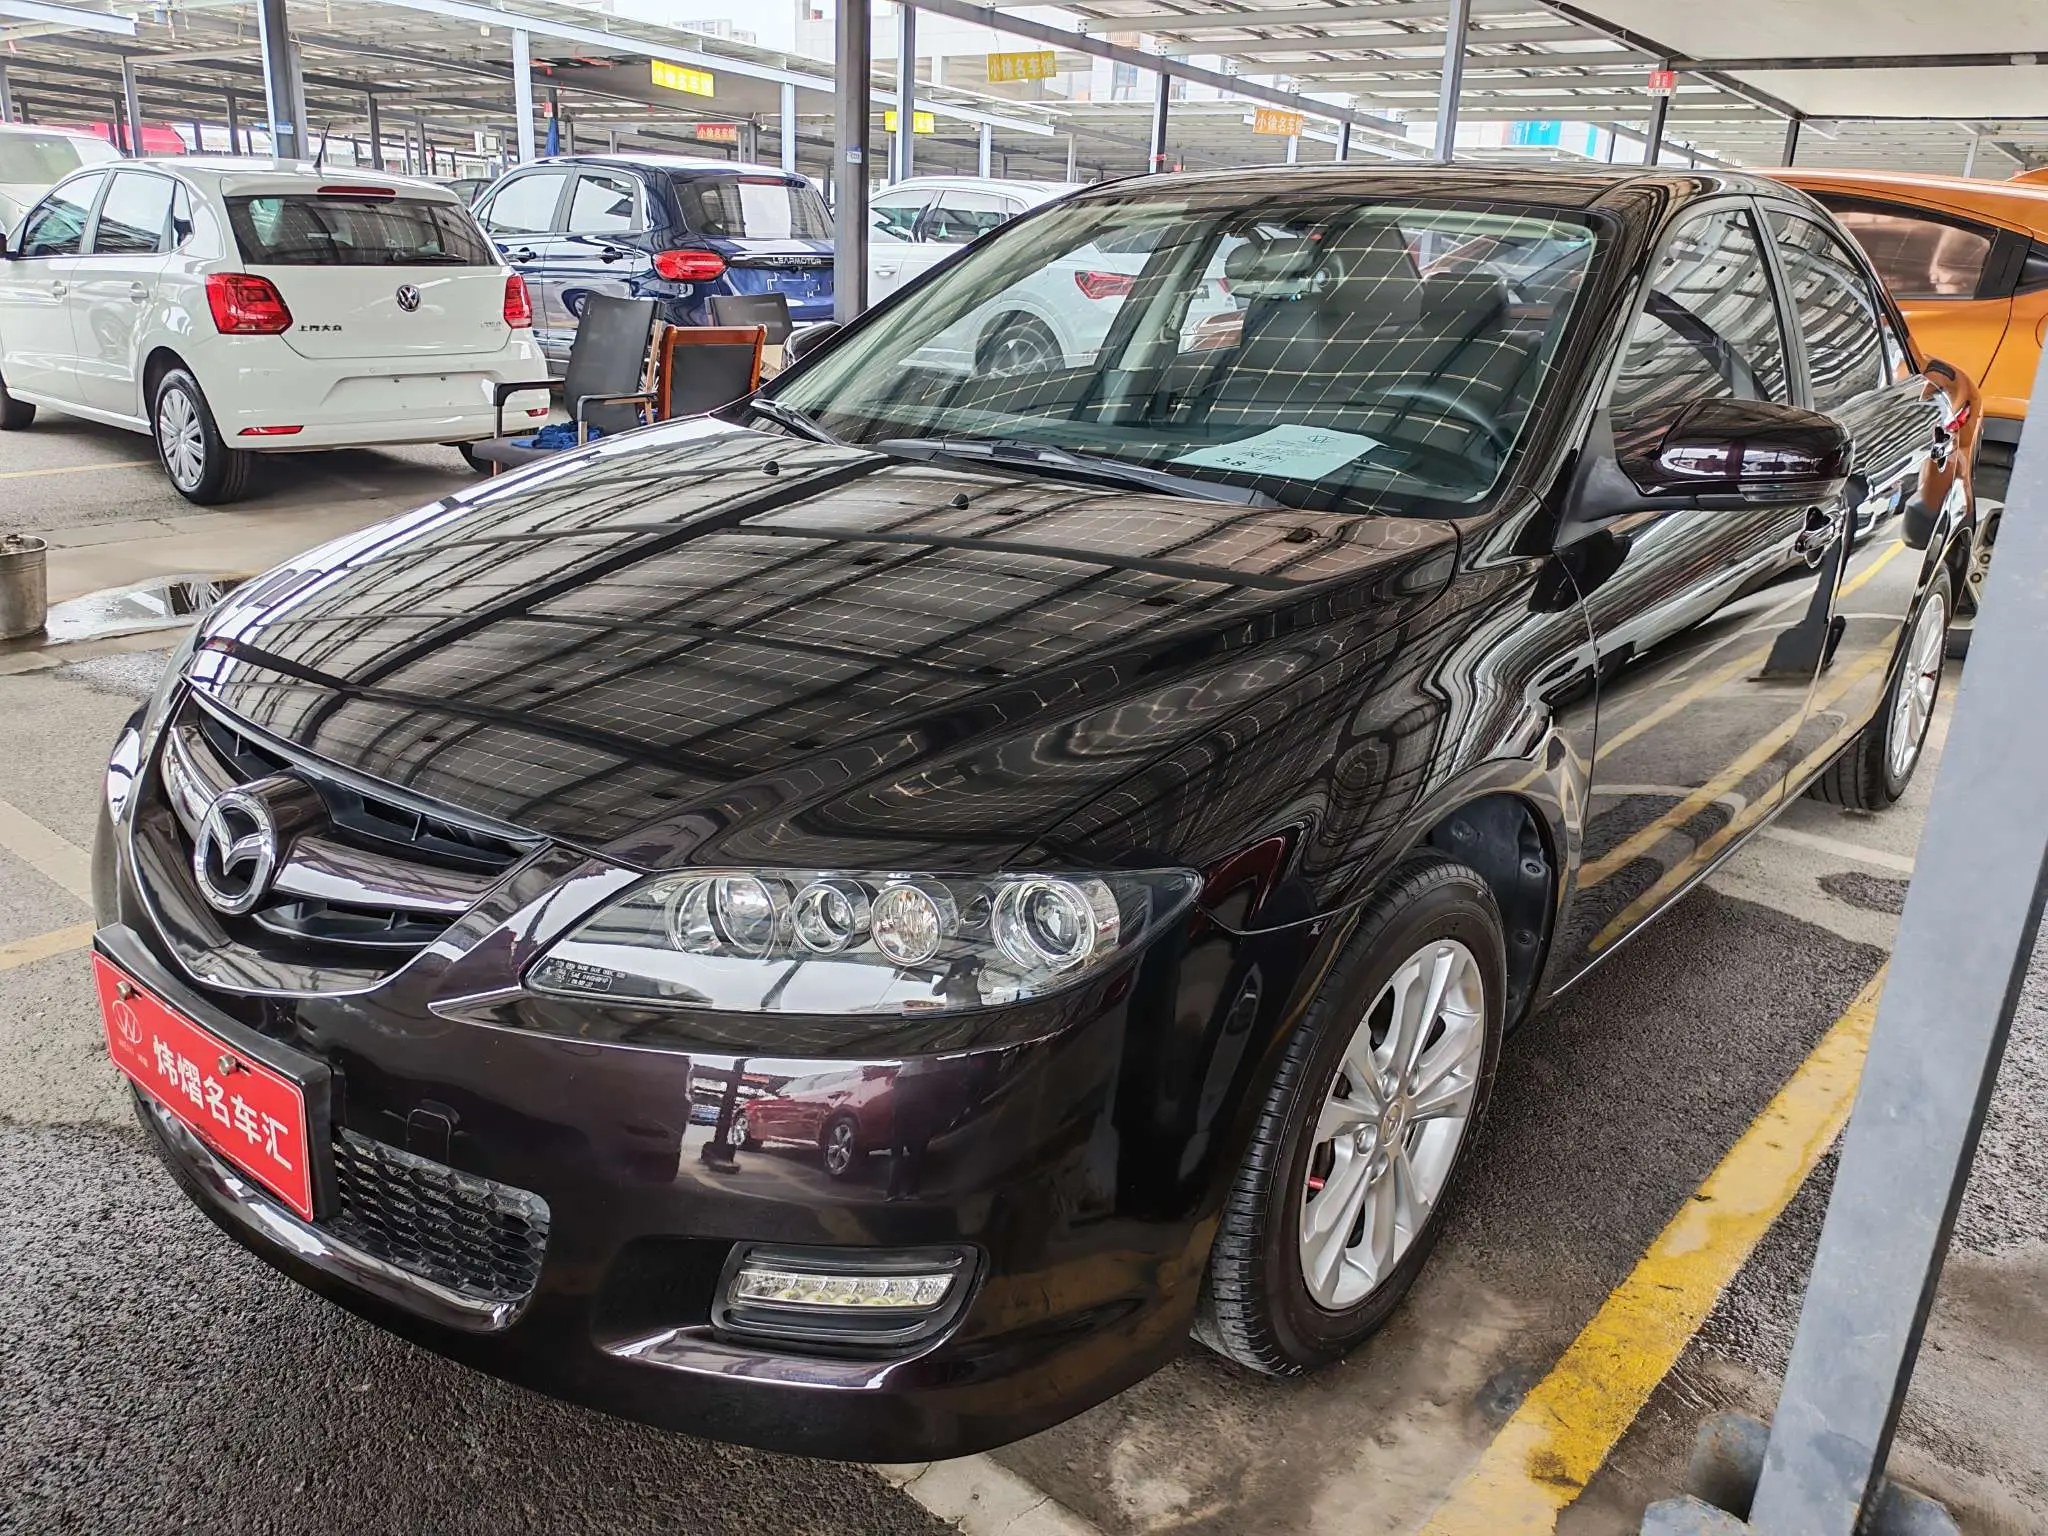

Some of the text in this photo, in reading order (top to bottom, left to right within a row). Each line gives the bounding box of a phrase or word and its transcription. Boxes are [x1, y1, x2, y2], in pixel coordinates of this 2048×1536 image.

[152, 1034, 293, 1171] 炜熠名车汇
